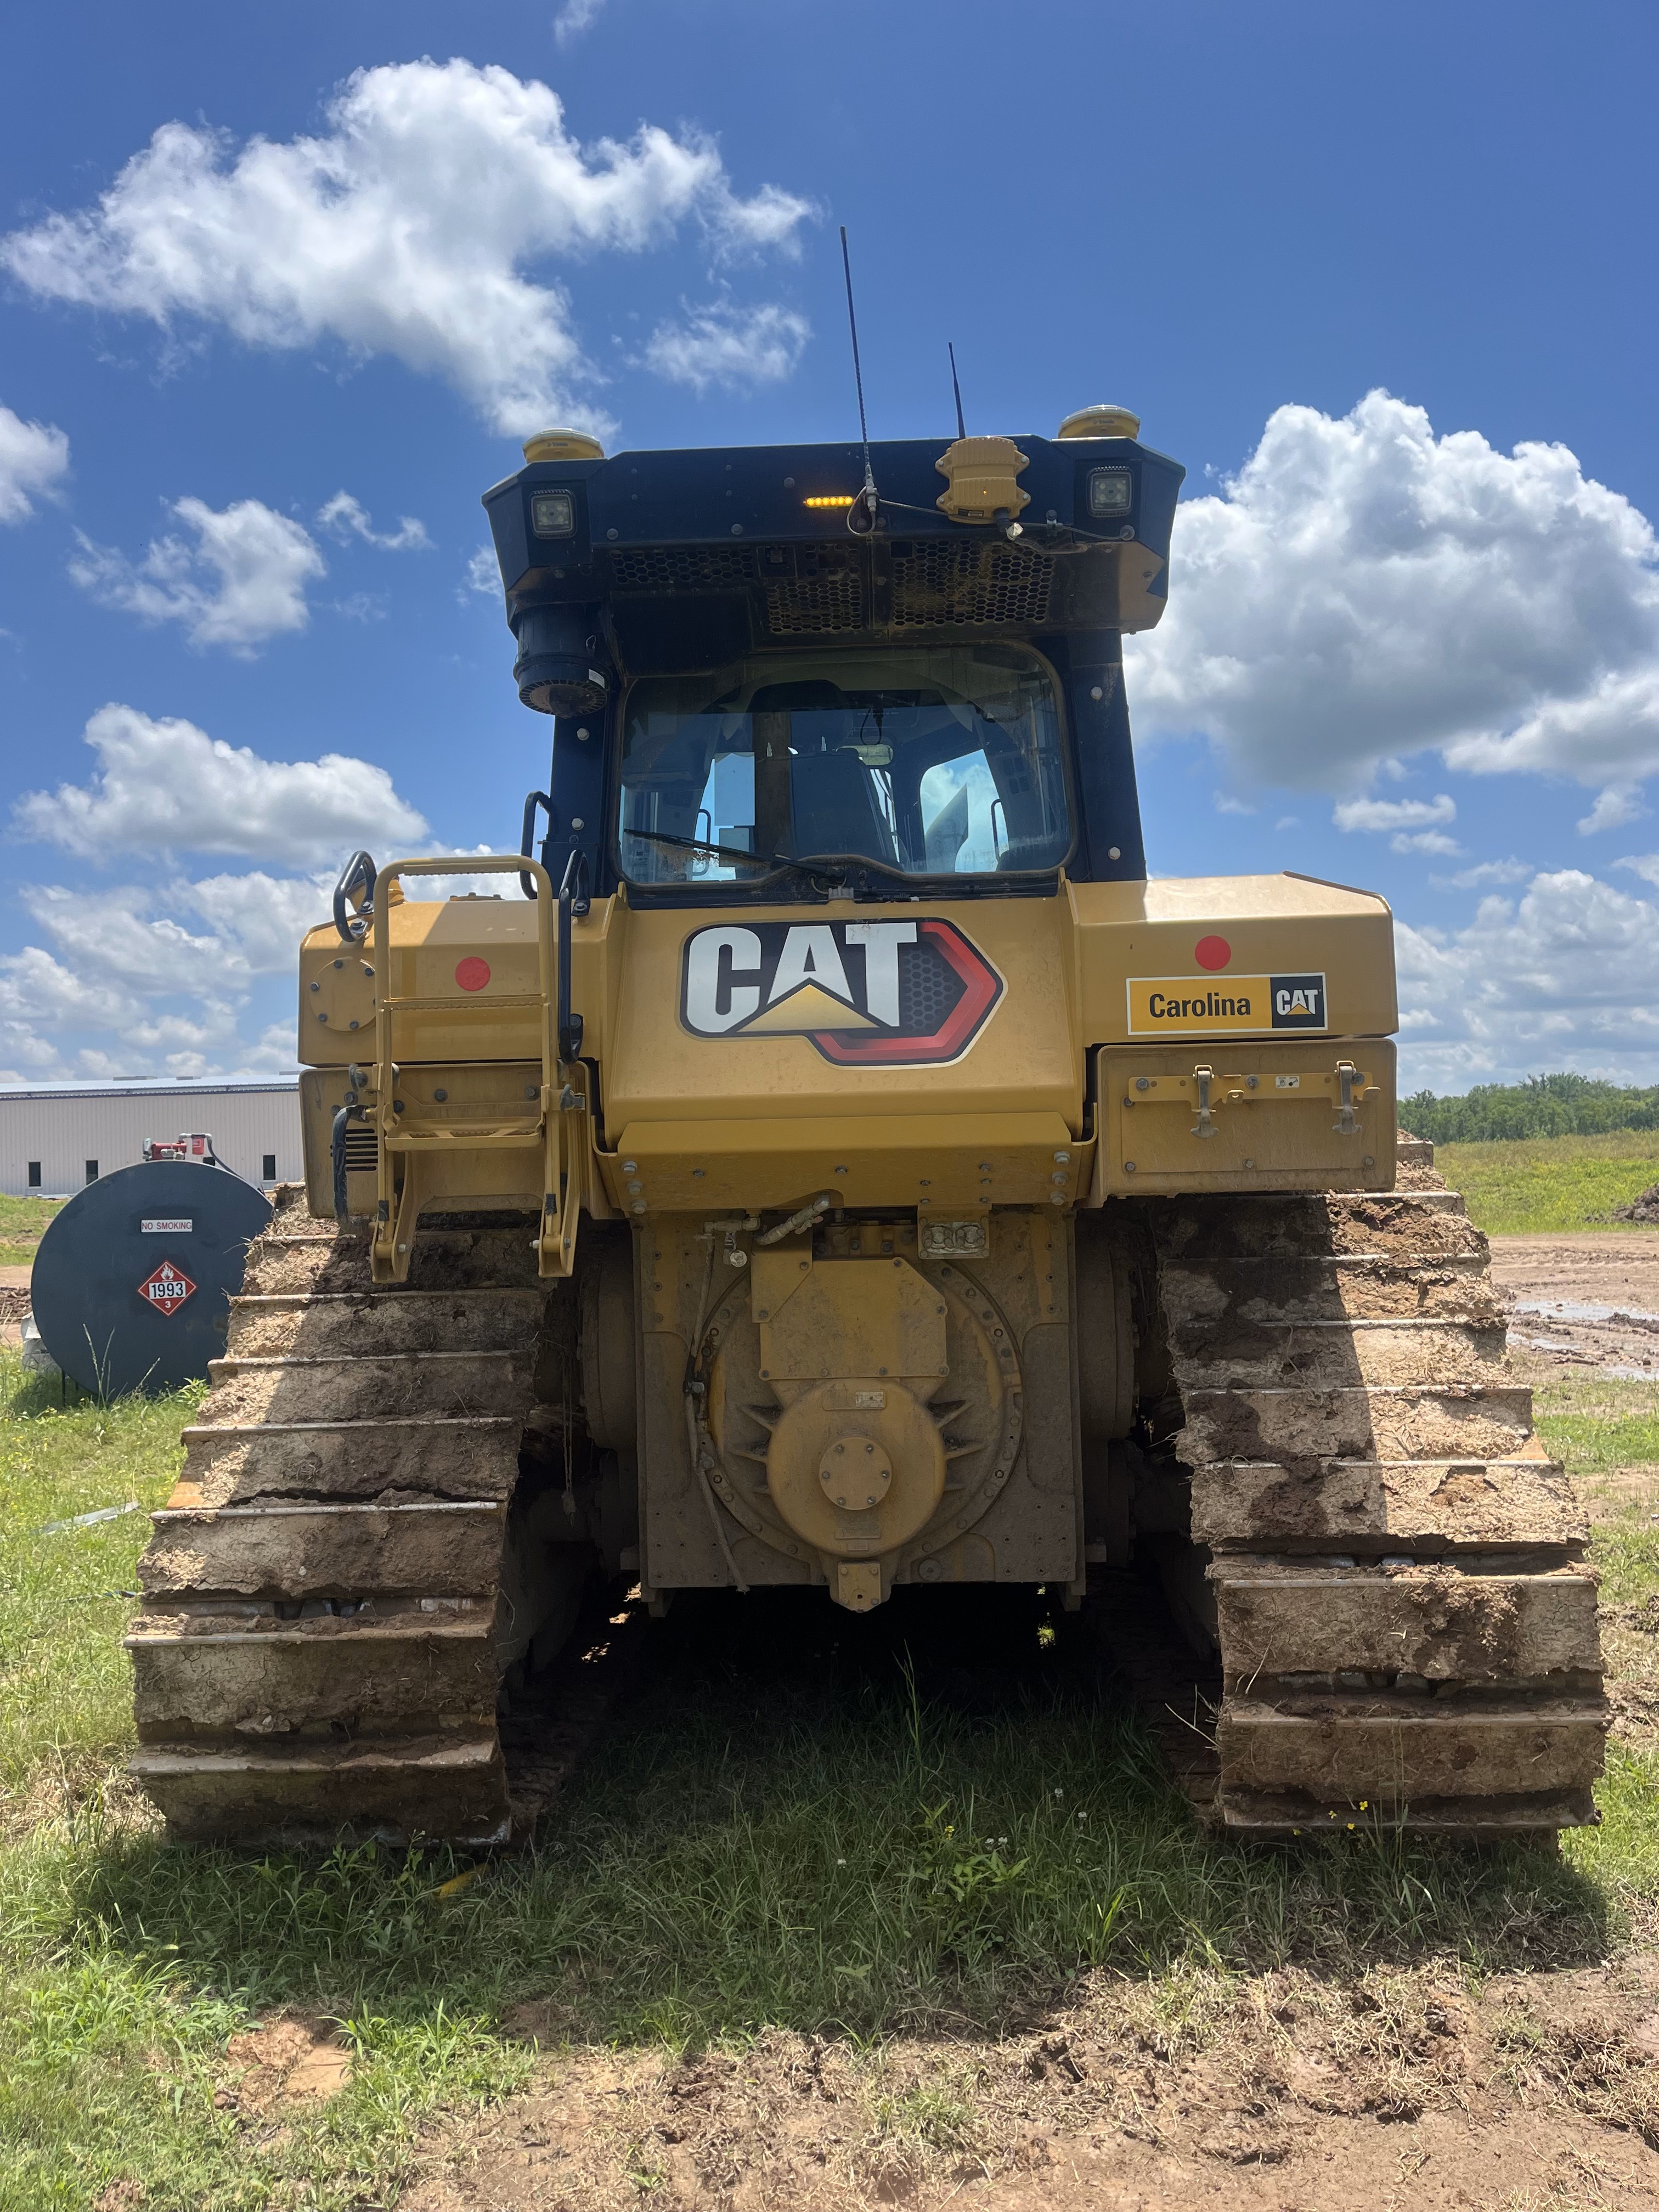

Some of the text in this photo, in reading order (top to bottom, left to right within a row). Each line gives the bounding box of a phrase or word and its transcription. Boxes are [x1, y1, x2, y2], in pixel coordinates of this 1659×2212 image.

[687, 922, 917, 1032] CAT
[1149, 989, 1318, 1018] Carolina CAT
[151, 1283, 183, 1297] 1993
[165, 1300, 171, 1308] 3
